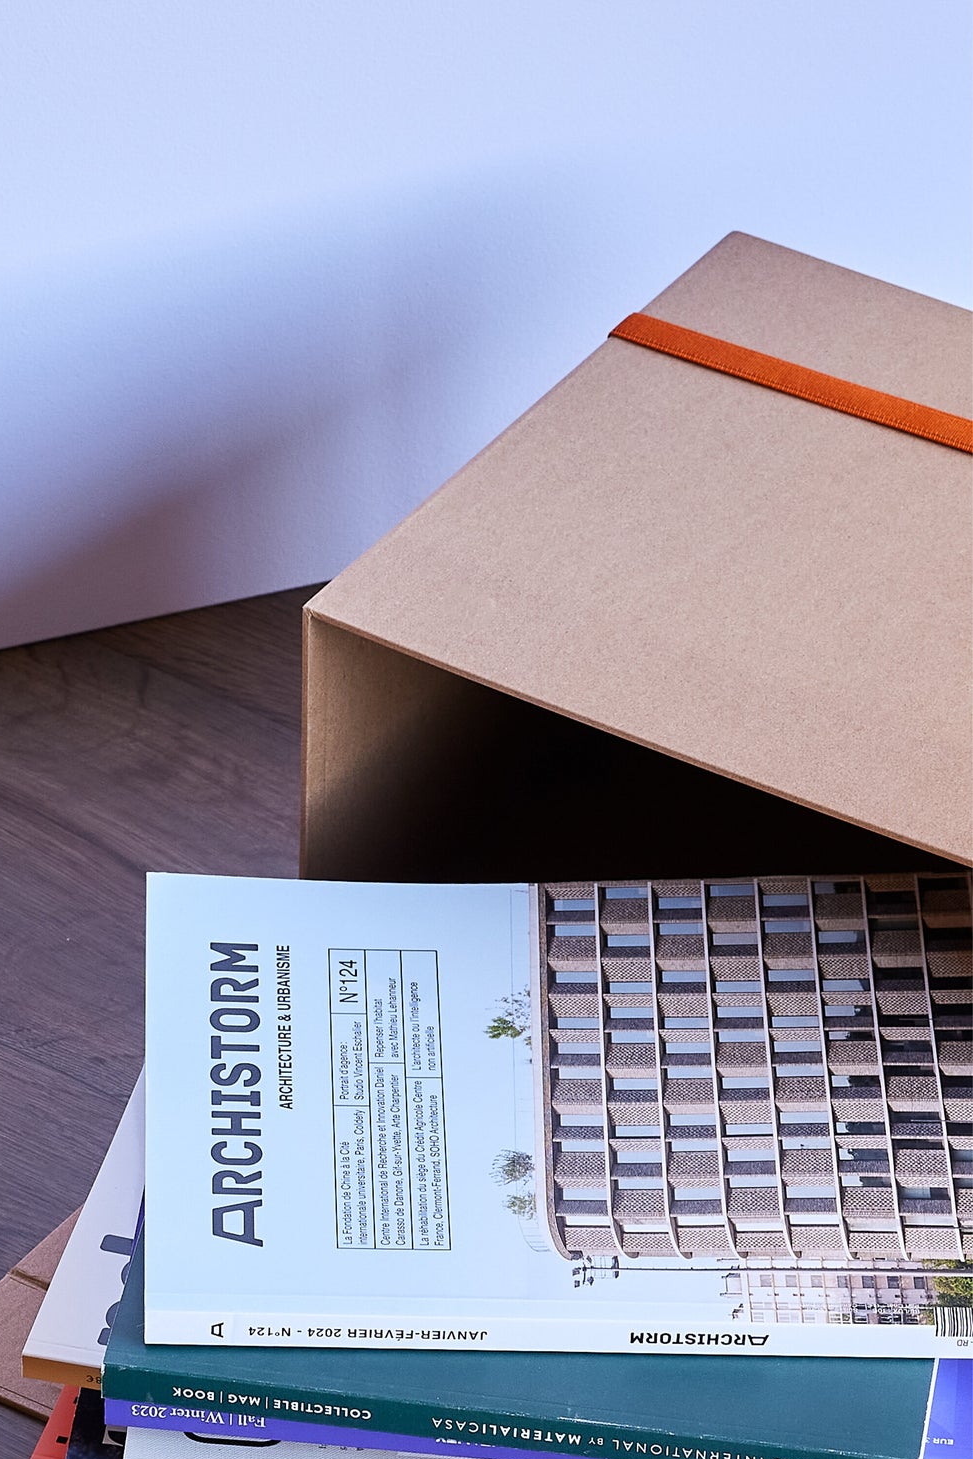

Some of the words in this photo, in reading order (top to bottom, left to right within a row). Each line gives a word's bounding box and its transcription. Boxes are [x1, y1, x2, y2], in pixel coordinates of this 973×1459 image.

[277, 945, 291, 1011] URBANISME
[339, 960, 358, 1003] N°124
[388, 978, 398, 1013] Lehanneur
[389, 1015, 398, 1041] Mathieu
[411, 1024, 420, 1032] ou
[374, 1026, 385, 1057] Repenser
[390, 1042, 399, 1058] avec
[279, 1024, 293, 1110] ARCHITECTURE
[353, 1053, 363, 1077] Vincent
[427, 1058, 436, 1070] non
[374, 1067, 384, 1087] Daniel
[209, 942, 263, 1247] ARCHISTORM
[340, 1076, 349, 1100] Portrait
[354, 1079, 364, 1100] Studio
[390, 1075, 401, 1113] Charpentier
[413, 1081, 423, 1103] Centre
[375, 1090, 386, 1123] Innovation
[429, 1095, 439, 1134] Architecture
[391, 1115, 400, 1128] Arte
[414, 1105, 427, 1131] Agricole
[340, 1142, 350, 1155] Cité
[377, 1133, 388, 1168] Recherche
[430, 1136, 440, 1157] SOHO
[416, 1154, 426, 1162] du
[340, 1170, 350, 1189] Chine
[378, 1171, 388, 1179] de
[341, 1192, 351, 1200] de
[417, 1184, 426, 1192] du
[379, 1181, 389, 1221] International
[342, 1202, 352, 1234] Fondation
[394, 1208, 404, 1216] de
[357, 1201, 367, 1245] internationale
[395, 1218, 405, 1245] Carasso
[380, 1223, 390, 1245] Centre
[419, 1237, 429, 1245] La
[248, 1326, 291, 1337] N°124
[308, 1327, 342, 1338] 2024
[347, 1328, 488, 1341] JANVIER-FÉVRIER
[629, 1332, 770, 1347] ARCHISTORM
[173, 1387, 215, 1401] BOOK
[228, 1393, 260, 1406] MAG
[131, 1404, 166, 1418] 2023
[170, 1409, 225, 1424] Winter
[274, 1399, 372, 1420] COLLECTIBLE
[238, 1414, 266, 1428] Fall
[431, 1417, 582, 1444] MATERIALICASA
[590, 1436, 604, 1446] BY
